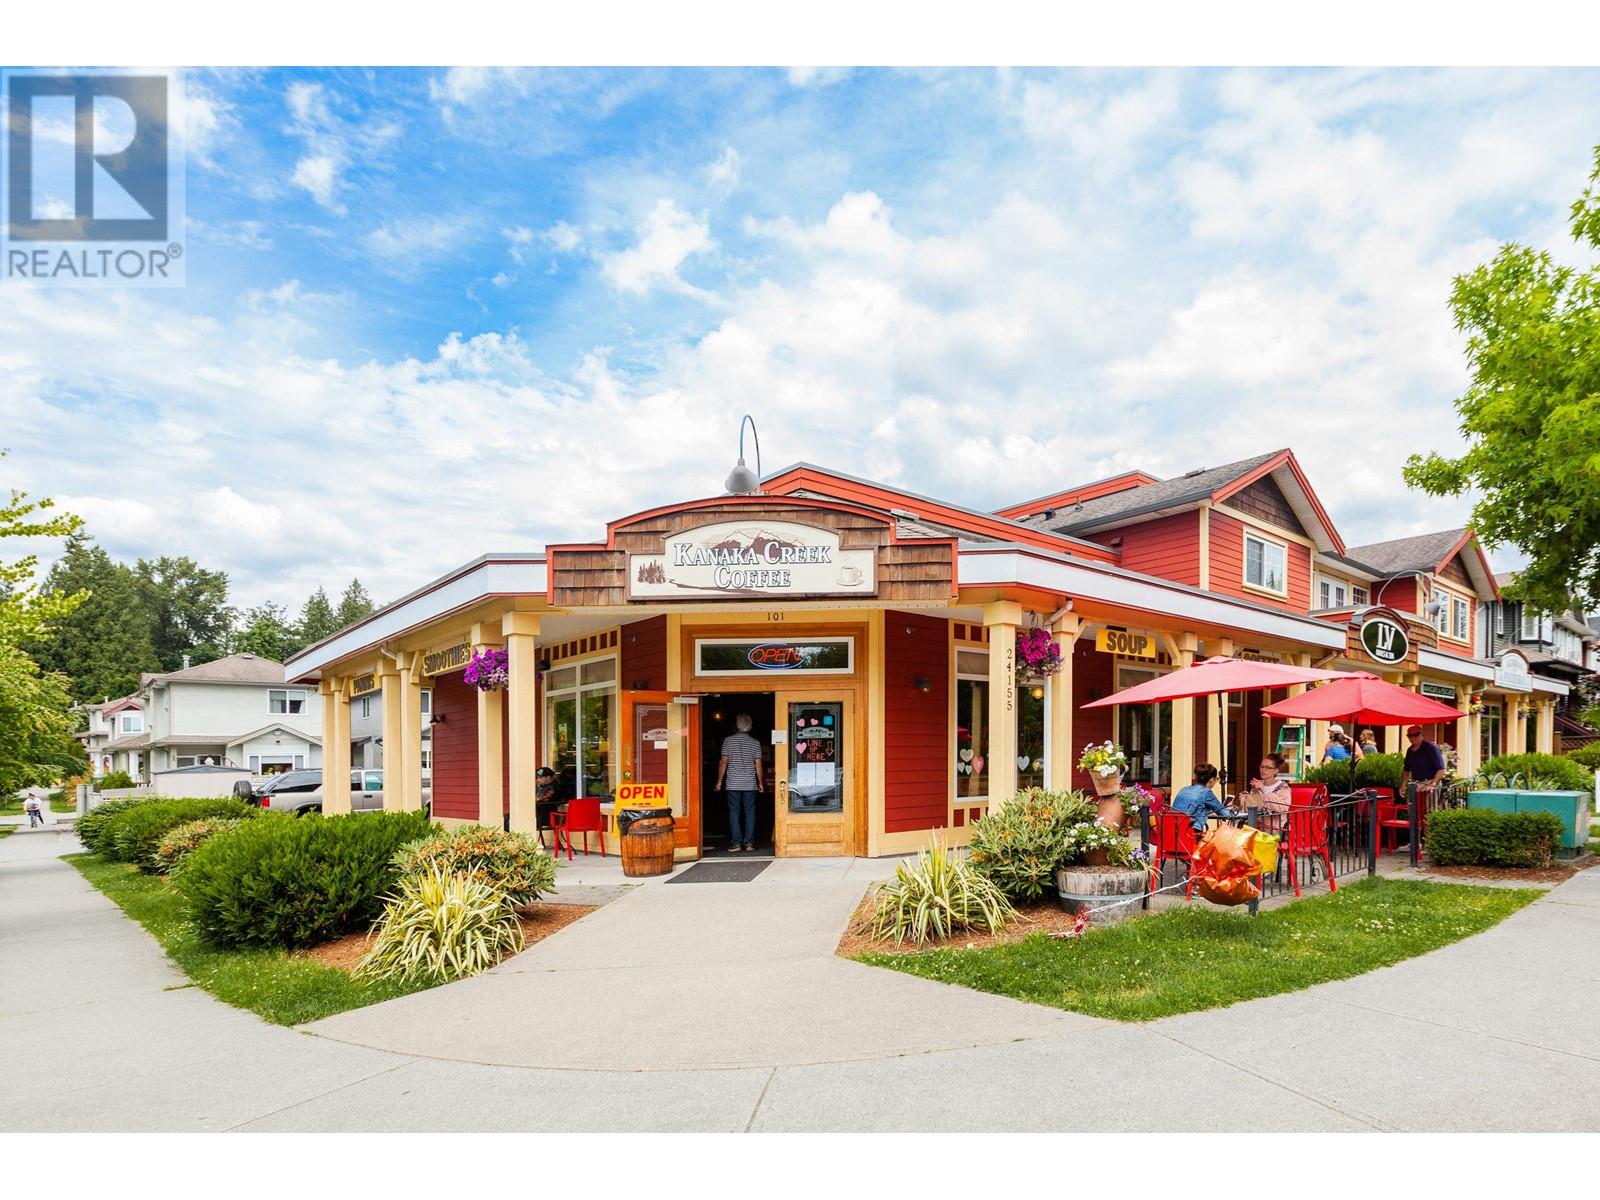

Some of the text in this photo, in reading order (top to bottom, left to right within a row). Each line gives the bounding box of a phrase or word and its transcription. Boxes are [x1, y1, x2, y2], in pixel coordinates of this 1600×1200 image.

[673, 541, 832, 567] KANAKA CREEK
[713, 565, 792, 589] COFFEE
[767, 611, 785, 622] 101
[749, 646, 802, 664] OPEN
[1105, 631, 1149, 655] SOUP
[423, 641, 472, 675] SMOOTHIES
[1006, 648, 1014, 712] 24155
[619, 785, 665, 800] OPEN
